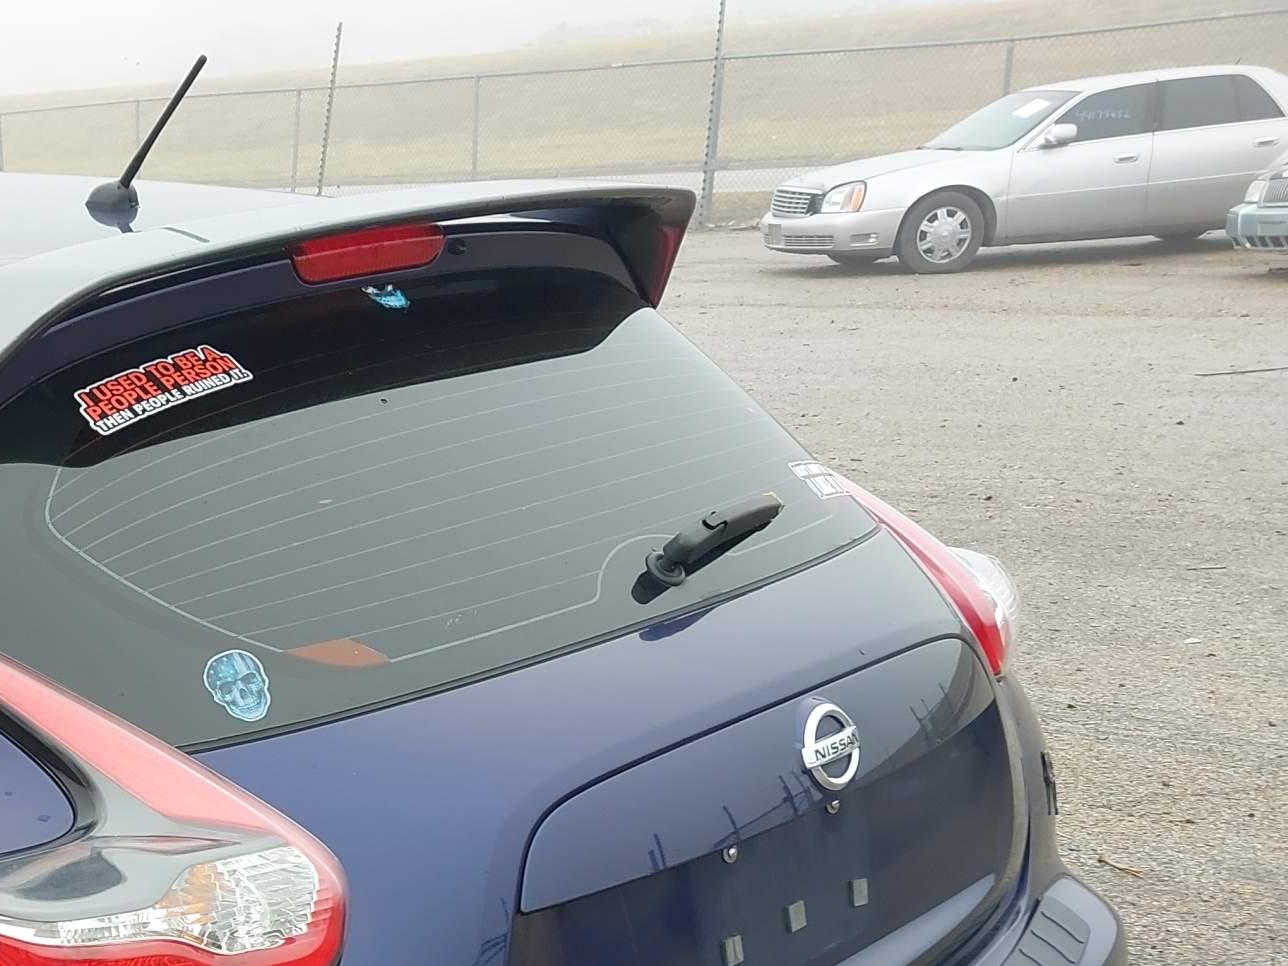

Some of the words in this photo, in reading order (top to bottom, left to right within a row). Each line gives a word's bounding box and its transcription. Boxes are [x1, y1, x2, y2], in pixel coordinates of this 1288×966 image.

[79, 392, 90, 406] I
[91, 370, 148, 401] USED
[145, 360, 175, 379] TO
[172, 351, 203, 370] BE
[202, 346, 221, 362] A
[85, 381, 162, 422] PEOPLE
[160, 355, 240, 391] PERSON
[96, 409, 135, 432] THEN
[137, 388, 185, 415] PEOPLE
[182, 373, 232, 397] RUINED
[814, 731, 859, 761] NISSAN
